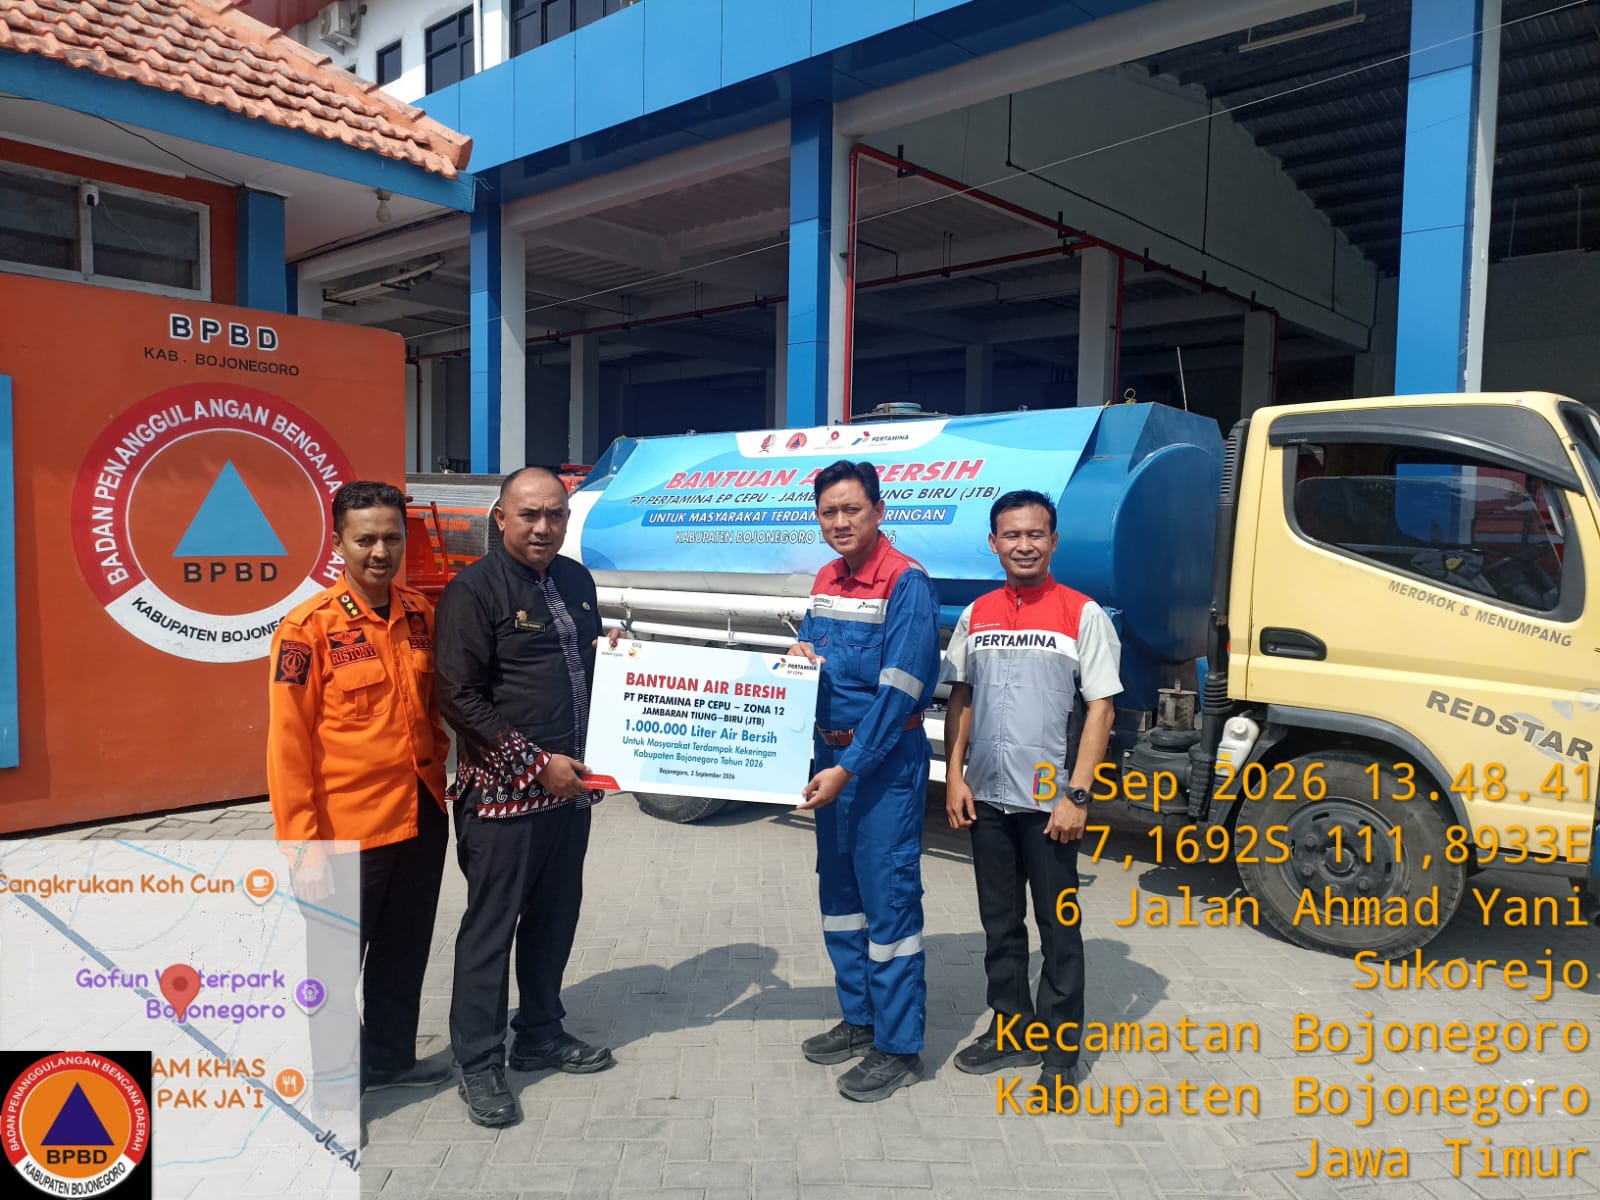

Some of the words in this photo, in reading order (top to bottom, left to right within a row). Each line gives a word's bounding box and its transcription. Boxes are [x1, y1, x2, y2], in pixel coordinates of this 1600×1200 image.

[169, 313, 279, 352] BPBD
[195, 353, 300, 376] BOJONEGORO
[94, 398, 270, 501] PENANGGULANGAN
[871, 434, 909, 442] PERTAMINA
[271, 414, 343, 494] BENCANA
[665, 468, 798, 489] BANTUAN
[629, 496, 646, 505] PT
[645, 494, 714, 505] PERTAMINA
[716, 493, 733, 503] EP
[734, 492, 769, 503] CEPU
[778, 491, 816, 502] JAMB
[880, 488, 914, 500] UNG
[917, 486, 958, 499] BIRU
[959, 486, 1001, 501] (JTB)
[648, 511, 687, 524] UNTUK
[688, 510, 768, 523] MASYARAKAT
[770, 510, 818, 522] TERDAM
[884, 508, 947, 521] RINGAN
[92, 506, 130, 586] BADAN
[674, 530, 735, 544] KABUPATEN
[735, 529, 815, 545] BOJONEGORO
[183, 562, 278, 583] BPBD
[131, 596, 218, 642] KABUPATEN
[221, 615, 286, 643] BOJONE
[1388, 579, 1457, 612] MEROKOK
[1459, 605, 1470, 617] &
[1474, 609, 1573, 647] MENUMPANG
[974, 633, 1057, 649] PERTAMINA
[787, 663, 818, 671] PERTAMINA
[625, 672, 699, 692] BANTUAN
[703, 679, 729, 695] AIR
[734, 682, 787, 700] BERSIH
[623, 692, 635, 702] PT
[637, 693, 691, 707] PERTAMINA
[694, 698, 705, 708] EP
[707, 700, 731, 710] CEPU
[743, 703, 771, 714] ZONA
[774, 706, 785, 716] 12
[642, 706, 688, 718] JAMBARAN
[745, 716, 765, 727] (JTB)
[1426, 689, 1594, 762] REDSTAR
[625, 718, 687, 736] 1.000.000
[691, 724, 717, 738] Liter
[720, 727, 738, 740] Air
[741, 729, 778, 744] Bersih
[622, 735, 645, 746] Untuk
[646, 737, 691, 750] Masyarakat
[693, 742, 733, 755] Terdampak
[735, 746, 777, 759] Kekeringan
[633, 748, 674, 761] Kabupaten
[675, 752, 719, 765] Bojonegoro
[721, 756, 743, 766] Tahun
[744, 758, 764, 768] 2026
[695, 770, 722, 778] September
